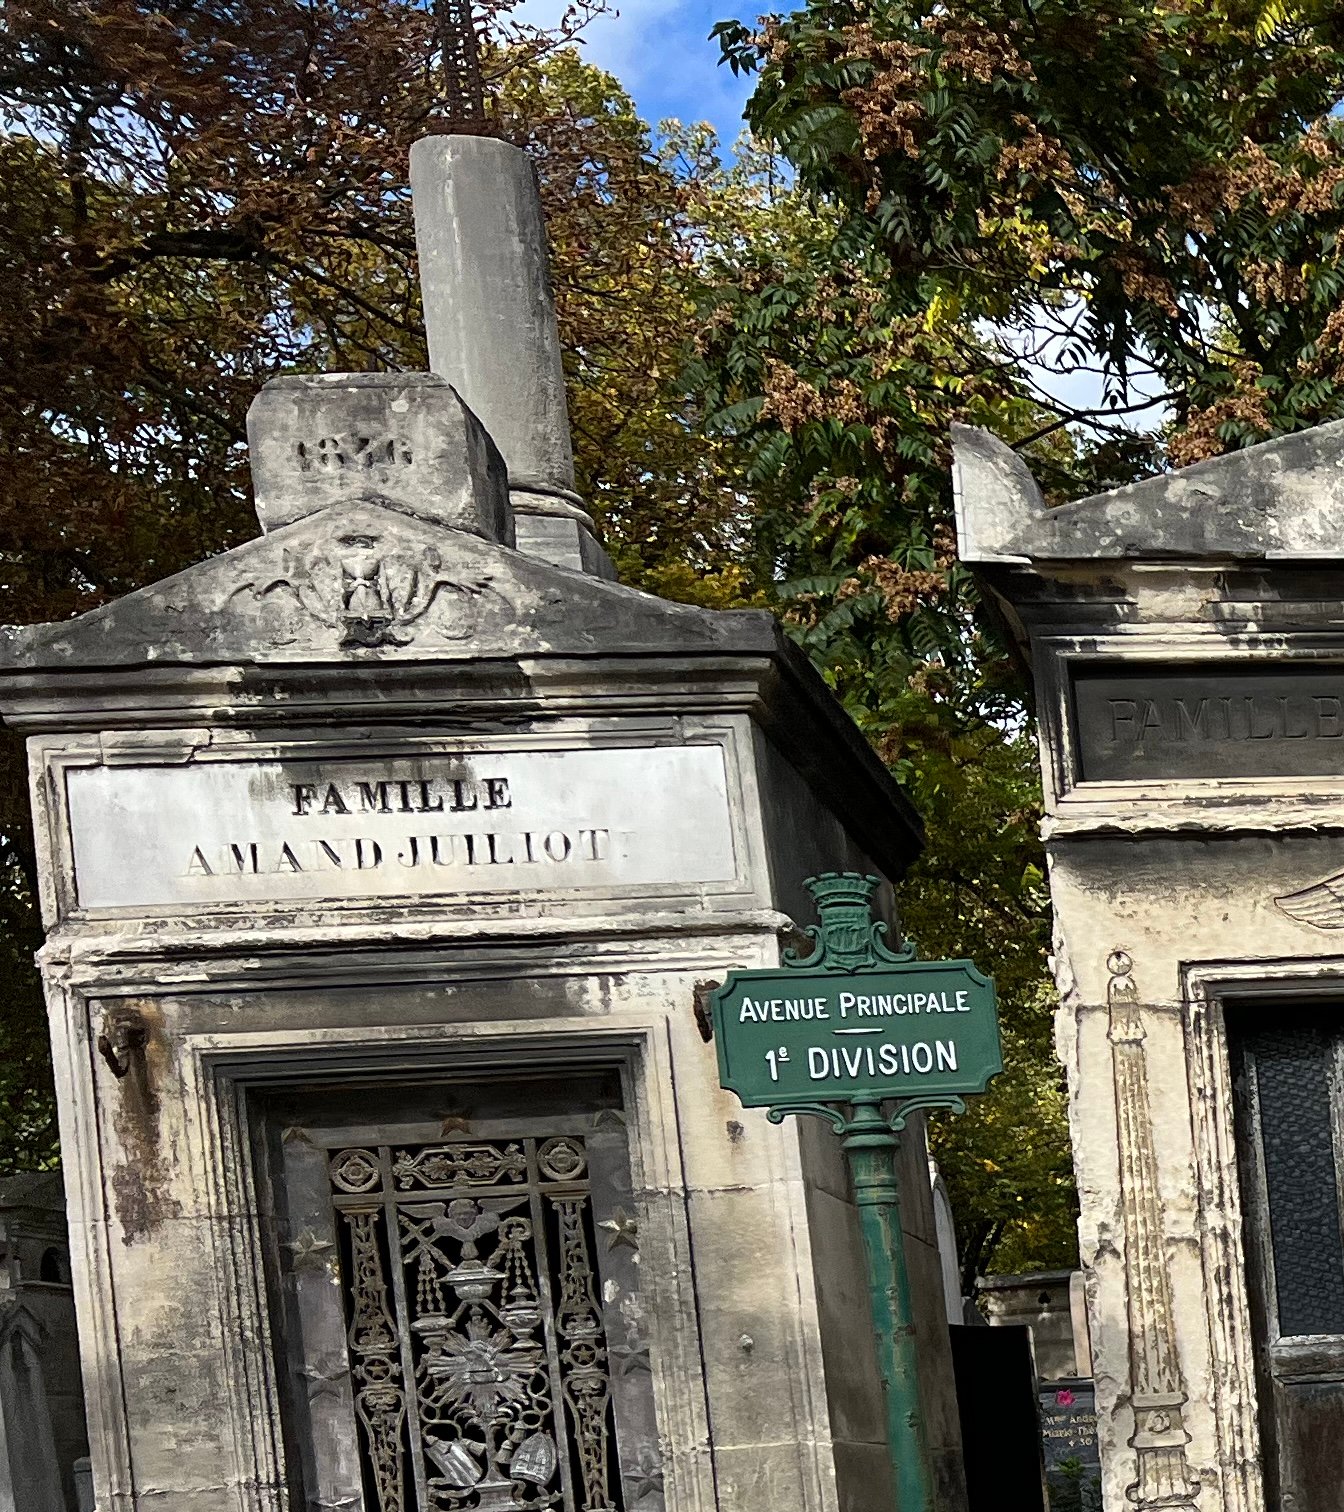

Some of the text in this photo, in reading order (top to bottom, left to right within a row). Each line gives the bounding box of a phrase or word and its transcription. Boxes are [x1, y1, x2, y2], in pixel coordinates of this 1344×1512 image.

[1105, 695, 1344, 742] FAMILLE
[288, 777, 512, 816] FAMILLE
[180, 836, 384, 877] AMAND
[739, 990, 971, 1023] AVENUE PRINCIPALE
[807, 1040, 959, 1080] DIVISION
